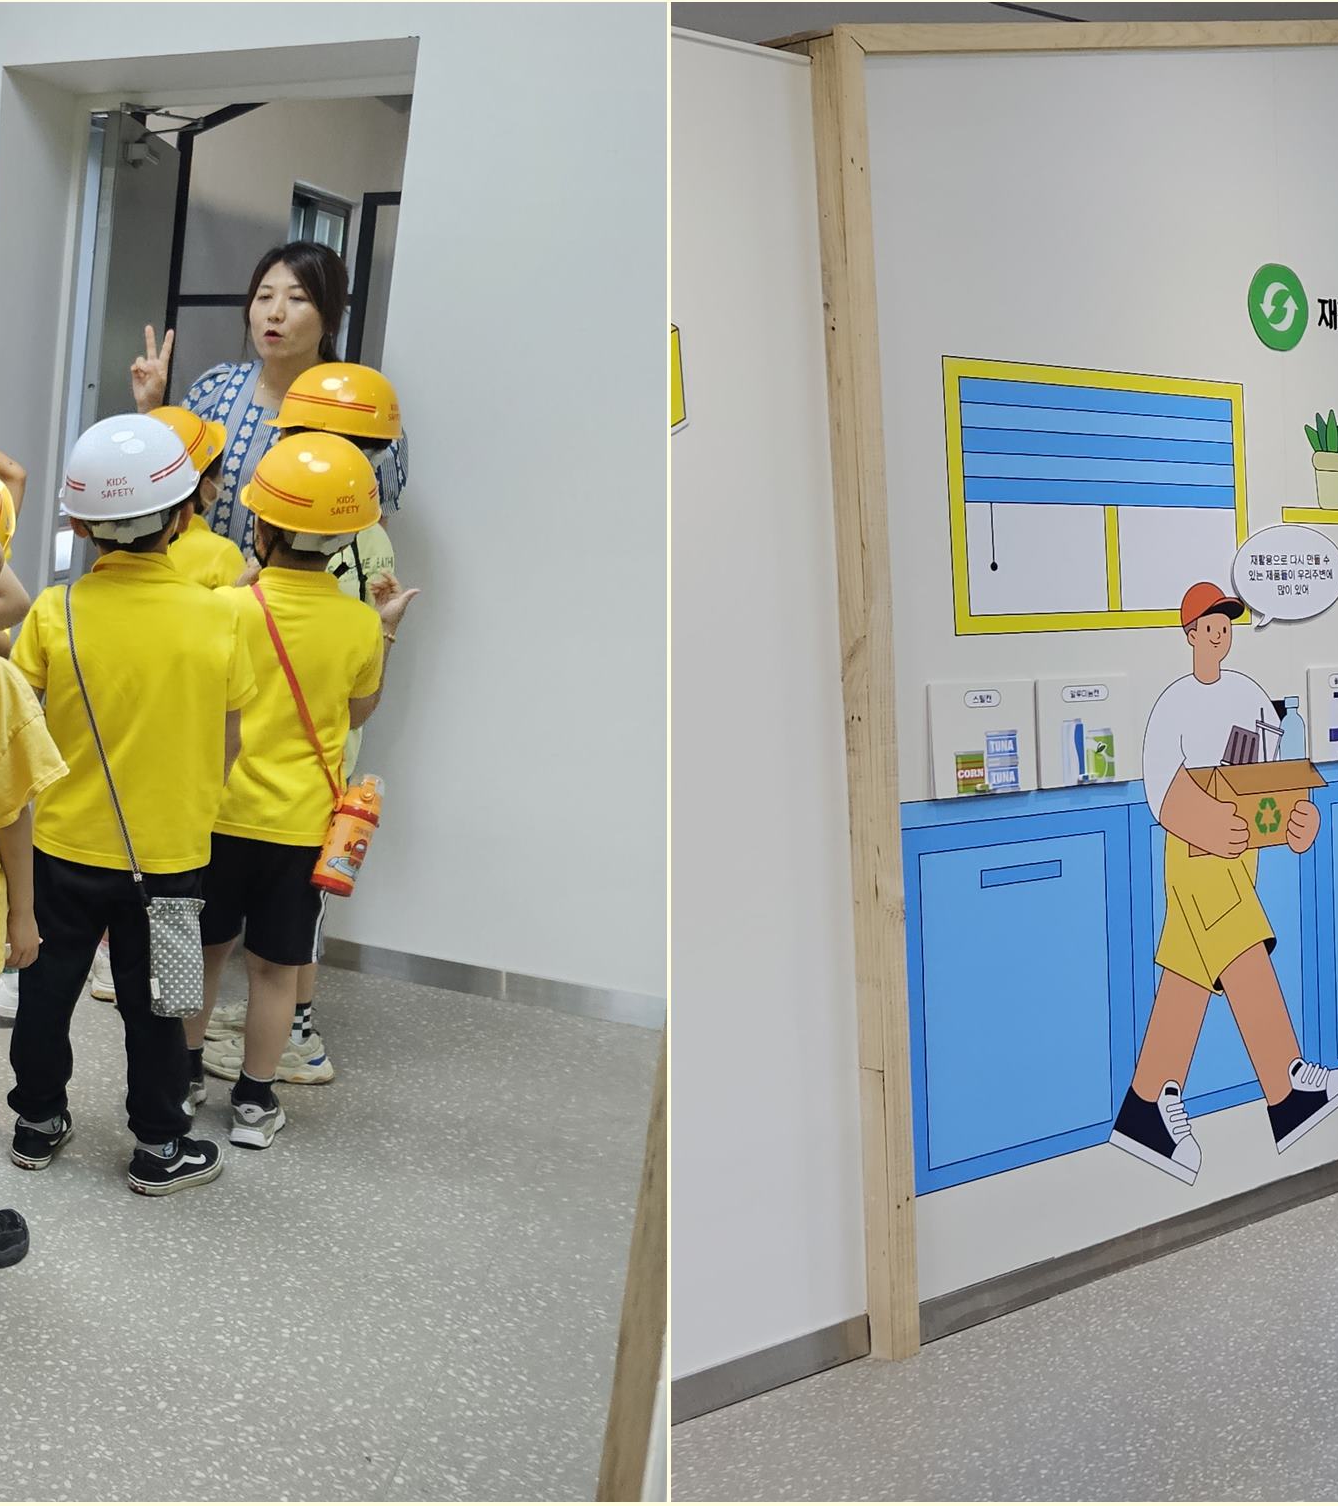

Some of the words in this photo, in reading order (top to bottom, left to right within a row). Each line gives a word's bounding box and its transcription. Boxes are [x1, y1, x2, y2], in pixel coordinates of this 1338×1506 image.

[105, 476, 128, 488] KIDS
[100, 486, 135, 500] SAFETY
[336, 495, 355, 505] KIDS
[330, 505, 360, 516] SAFETY
[1250, 554, 1288, 566] 재활용으로
[1290, 554, 1305, 566] 다시
[1306, 554, 1321, 566] 만들
[1323, 554, 1330, 566] 수
[1248, 569, 1264, 582] 있는
[1265, 569, 1296, 581] 제품들이
[1277, 584, 1293, 596] 많이
[1295, 584, 1310, 596] 있어
[972, 694, 992, 704] 스틸캔
[1070, 689, 1100, 699] 알루미늄캔
[990, 739, 1014, 753] TUNA
[957, 768, 984, 780] CORN
[991, 771, 1016, 784] TUNA
